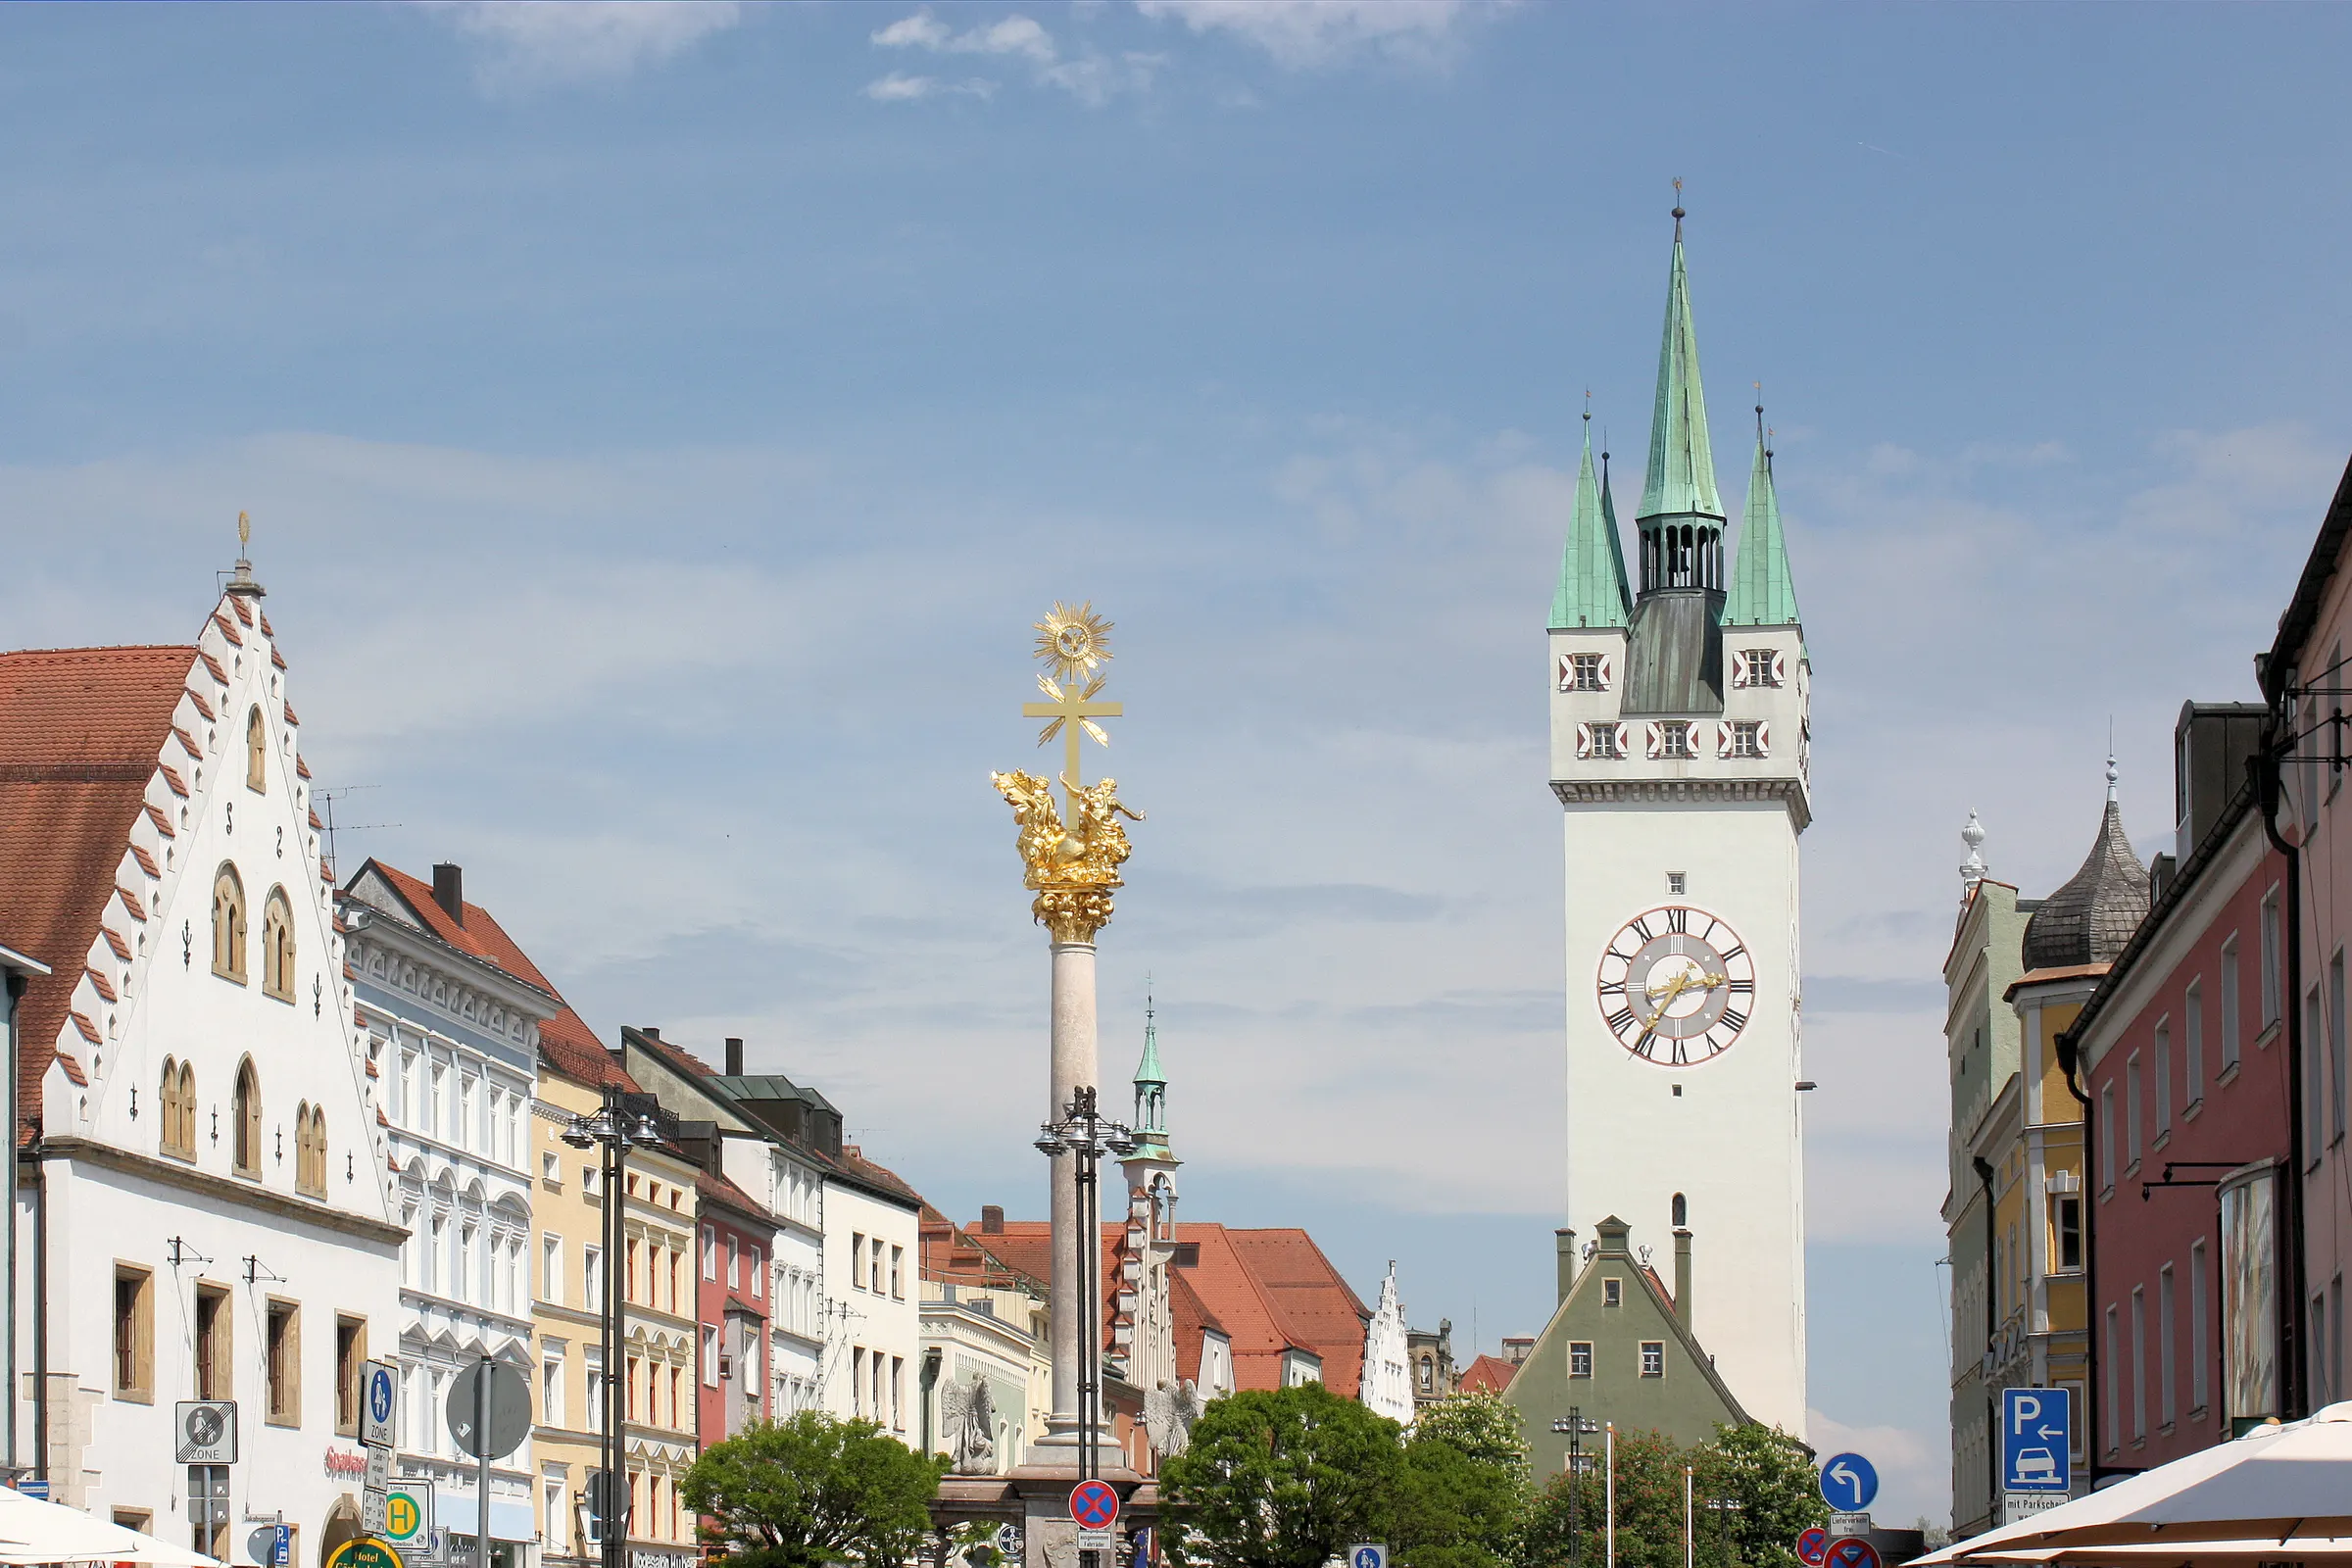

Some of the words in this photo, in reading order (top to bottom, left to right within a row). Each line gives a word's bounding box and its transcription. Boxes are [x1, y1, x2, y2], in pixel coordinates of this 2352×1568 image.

[1628, 917, 1654, 945] XI
[1666, 909, 1687, 933] XII
[1703, 918, 1717, 940] I
[1607, 945, 1633, 966] X
[1720, 944, 1744, 962] II
[1599, 979, 1625, 995] IX
[1730, 979, 1753, 995] III
[1606, 1005, 1636, 1038] VIII
[1671, 1039, 1690, 1064] VI
[1705, 1032, 1724, 1055] V
[2014, 1396, 2041, 1435] P
[371, 1424, 387, 1441] ZONE
[191, 1449, 220, 1459] ZONE
[2008, 1499, 2020, 1509] mit
[390, 1503, 409, 1530] H
[276, 1527, 284, 1543] P
[354, 1552, 379, 1563] Hotel
